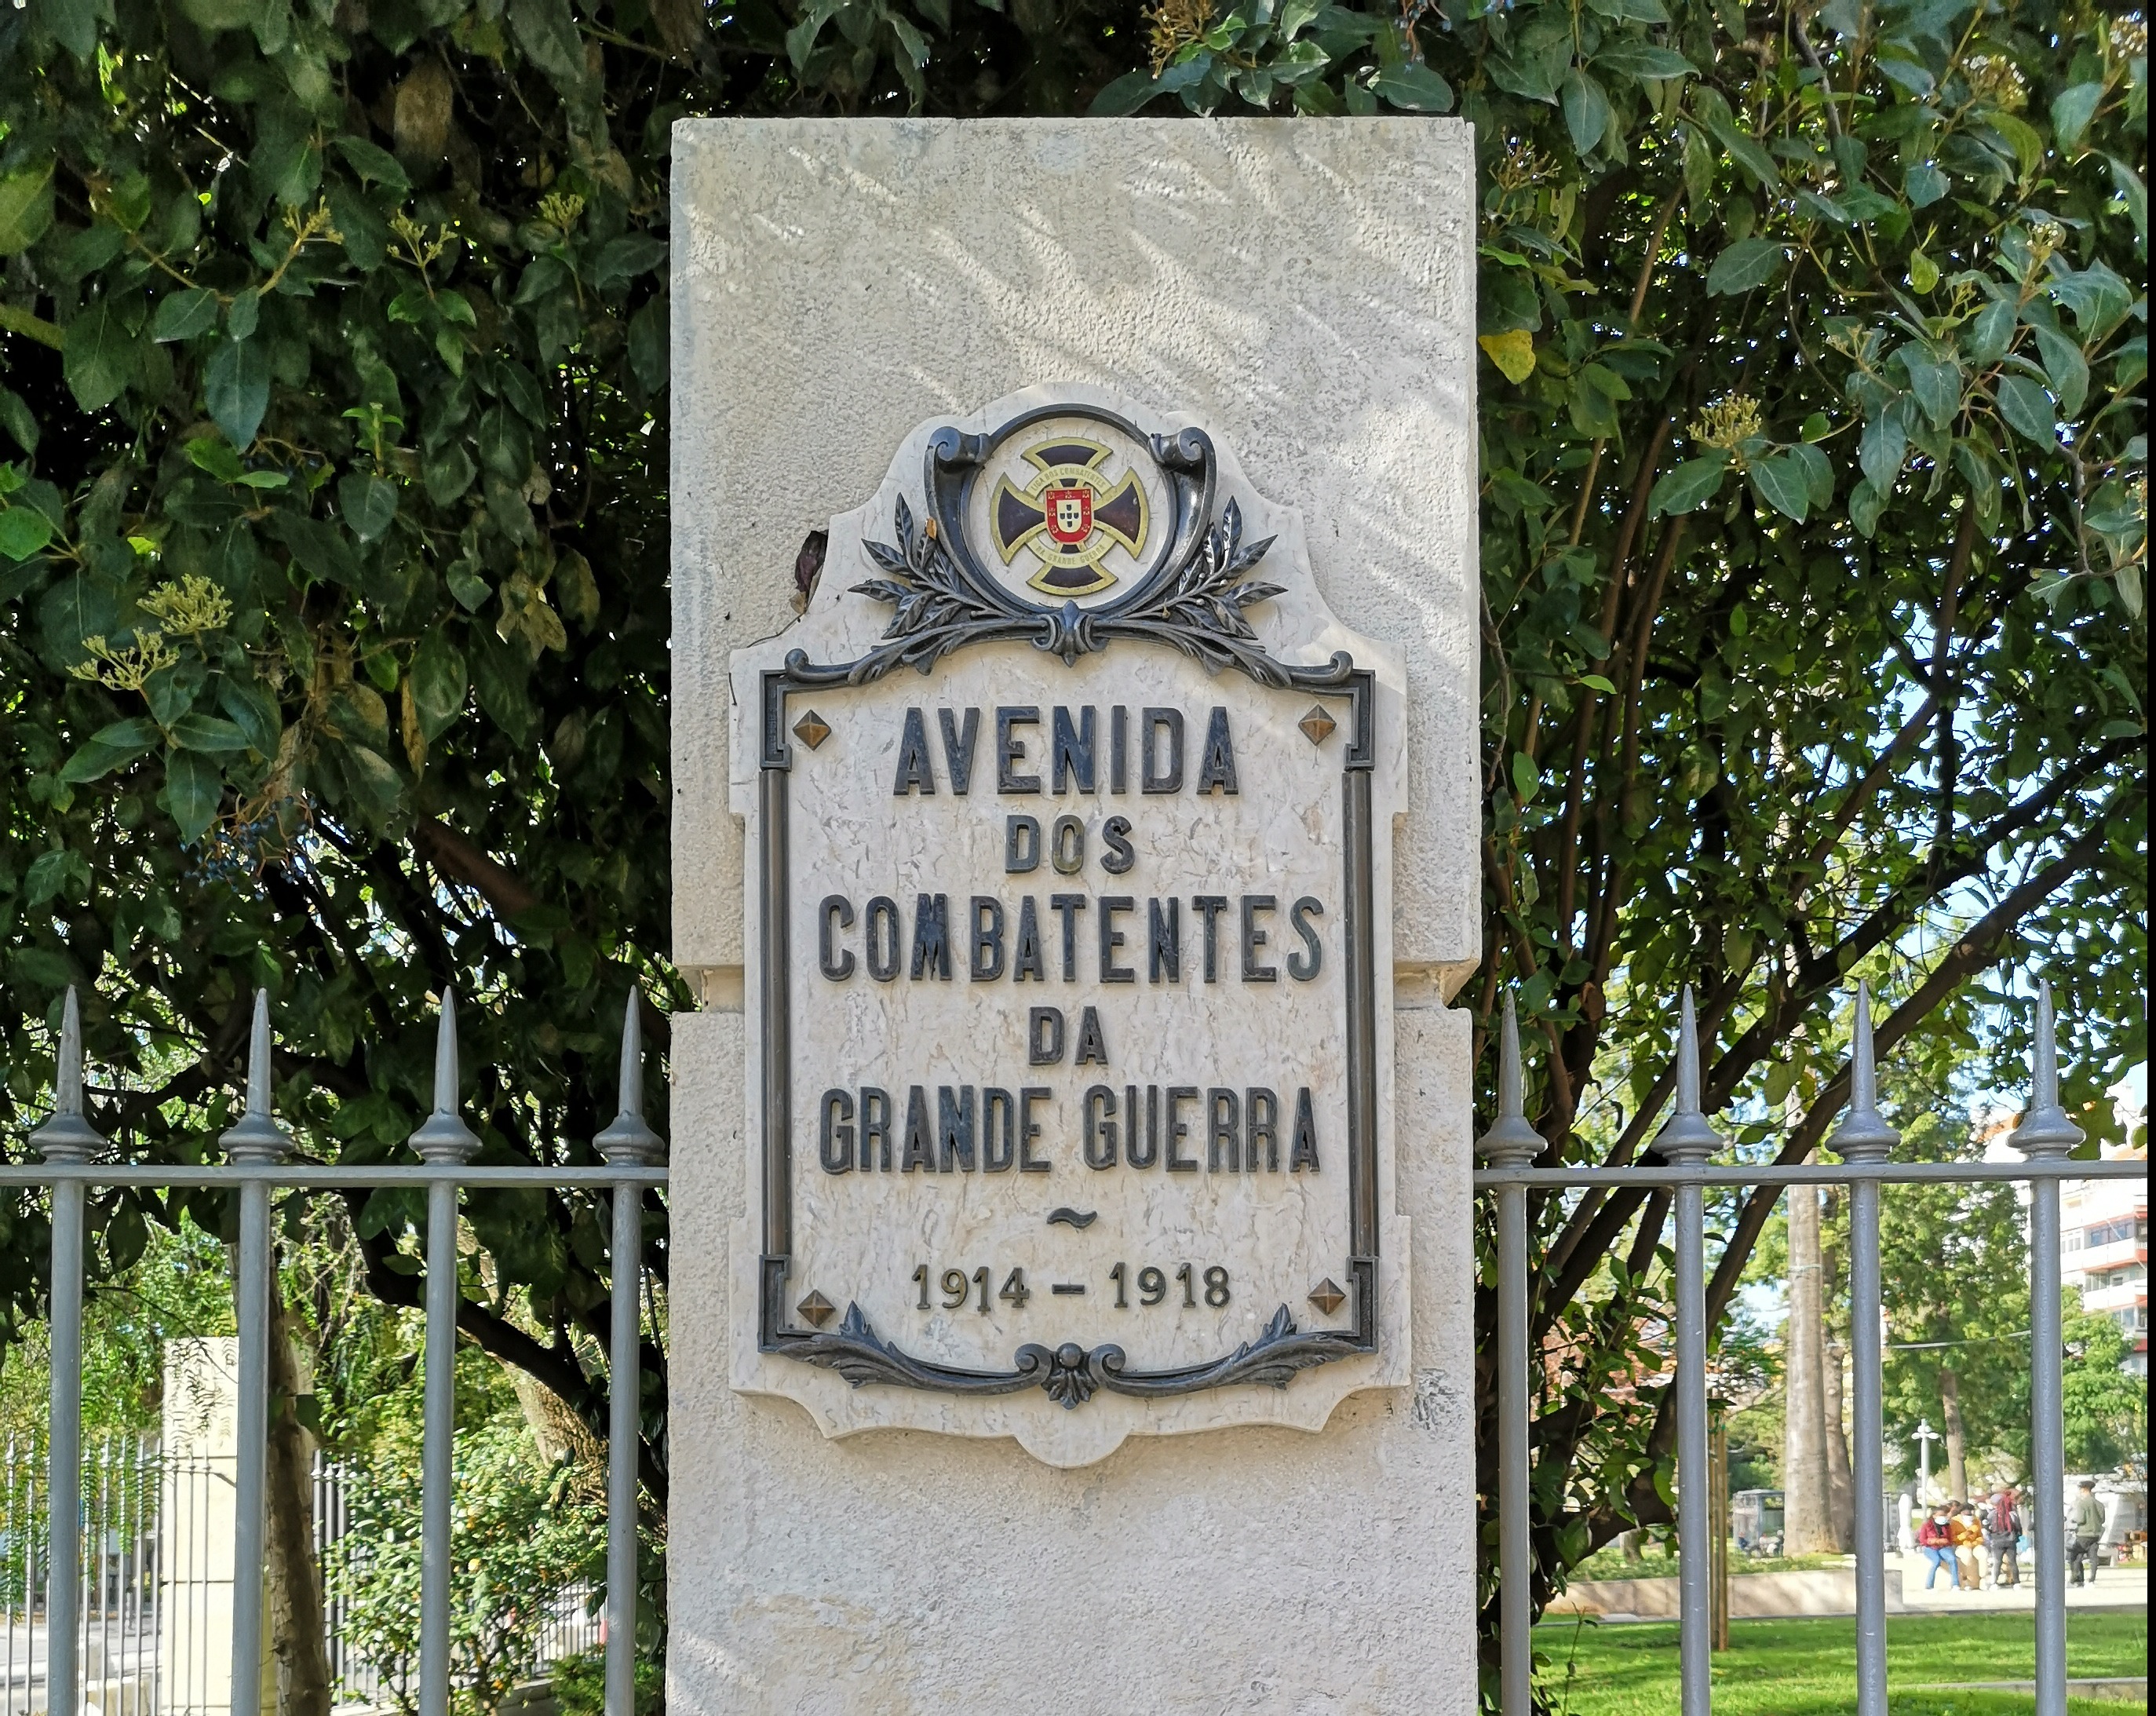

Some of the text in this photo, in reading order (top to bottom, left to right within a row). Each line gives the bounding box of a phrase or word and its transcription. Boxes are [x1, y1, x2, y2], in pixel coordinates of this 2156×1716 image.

[1031, 467, 1106, 491] LIGA DOS COMBATENTES
[1048, 554, 1075, 564] GRANDE
[1080, 544, 1106, 563] GUERRA
[892, 705, 1239, 795] AVENIDA
[1005, 814, 1136, 875] DOS
[818, 893, 1324, 984] COMBATENTES
[1028, 1006, 1109, 1065] DA
[819, 1084, 1322, 1175] GRANDE GUERRA
[911, 1262, 1031, 1313] 1914
[1109, 1261, 1231, 1309] 1918
